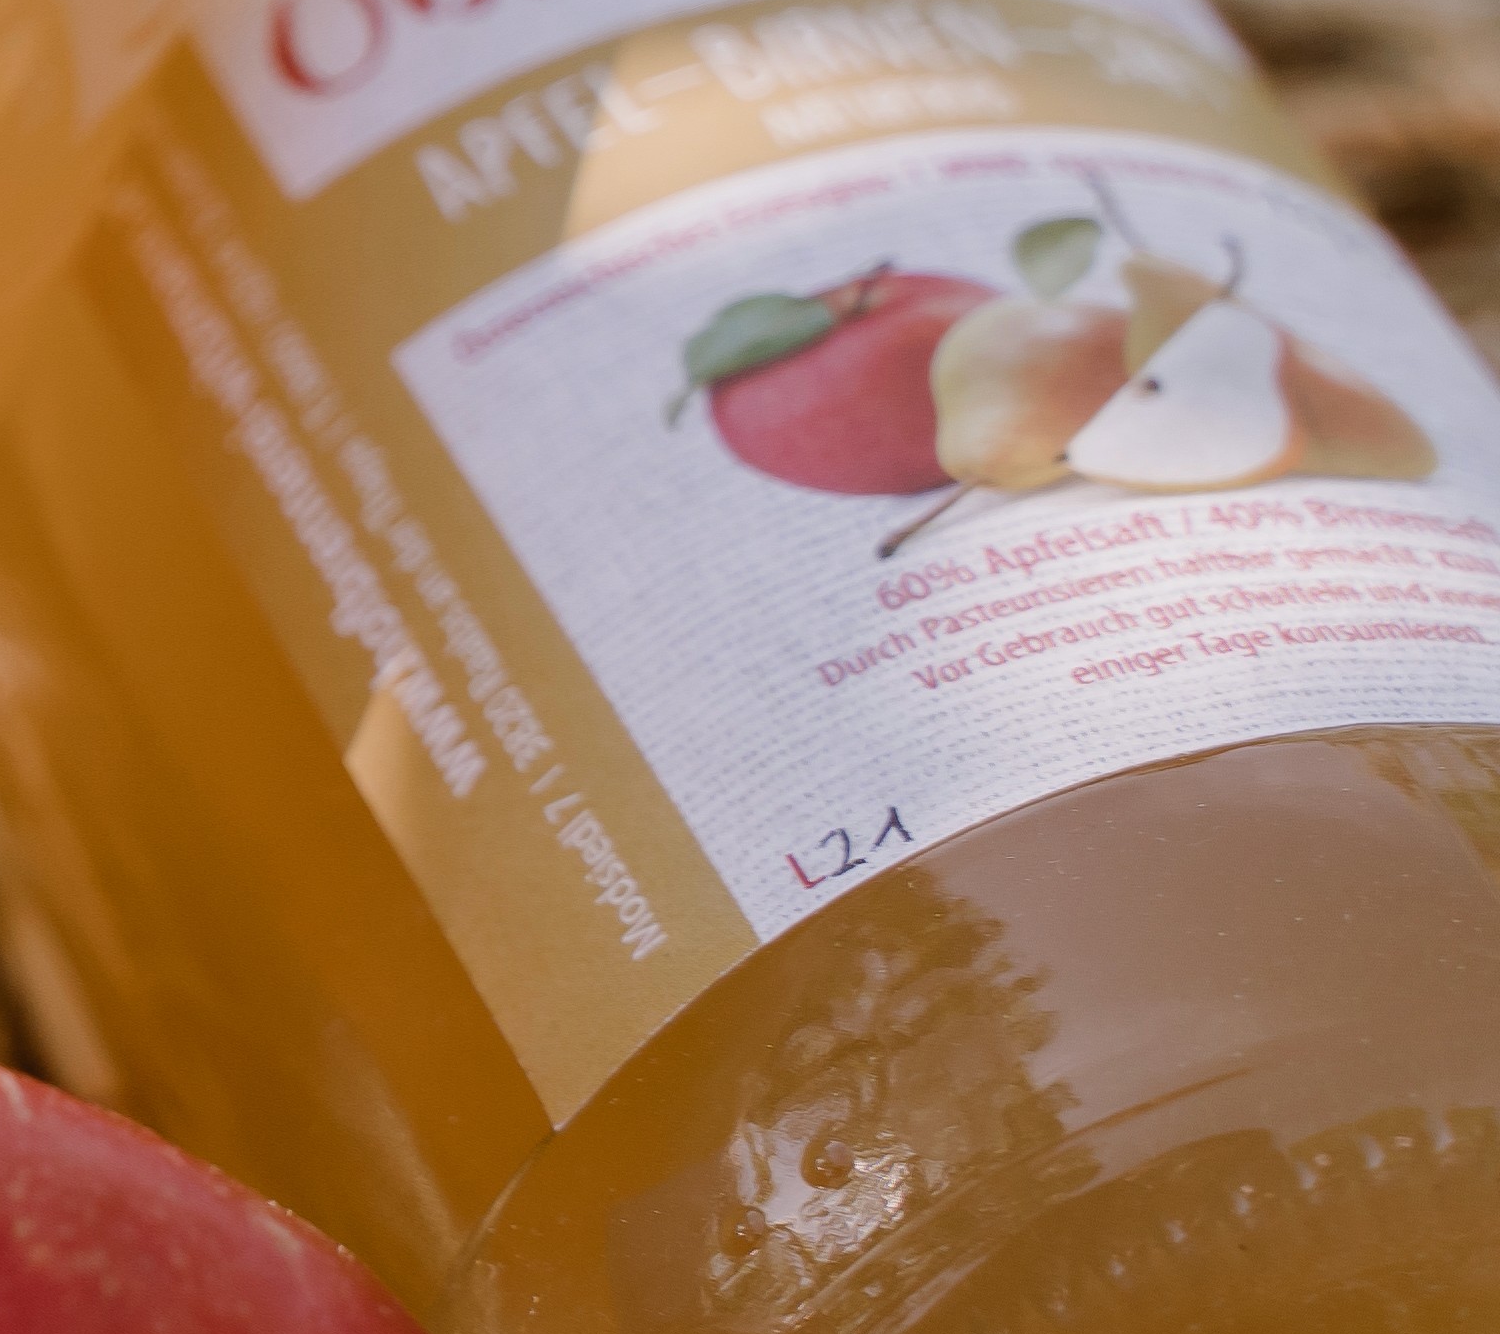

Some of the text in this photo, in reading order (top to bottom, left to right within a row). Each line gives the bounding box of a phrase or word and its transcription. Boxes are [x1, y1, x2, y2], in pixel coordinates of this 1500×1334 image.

[877, 558, 977, 611] 60%
[982, 512, 1171, 576] Apfelsaft
[819, 632, 917, 686] Durch
[918, 565, 1152, 641] Pasteurisieren
[911, 656, 973, 690] Vor
[976, 608, 1140, 669] Gebrauch
[1145, 595, 1206, 630] gut
[1070, 641, 1189, 686] einiger
[1187, 627, 1274, 658] Tage
[542, 791, 582, 824] 7
[557, 809, 669, 963] Modsiedl
